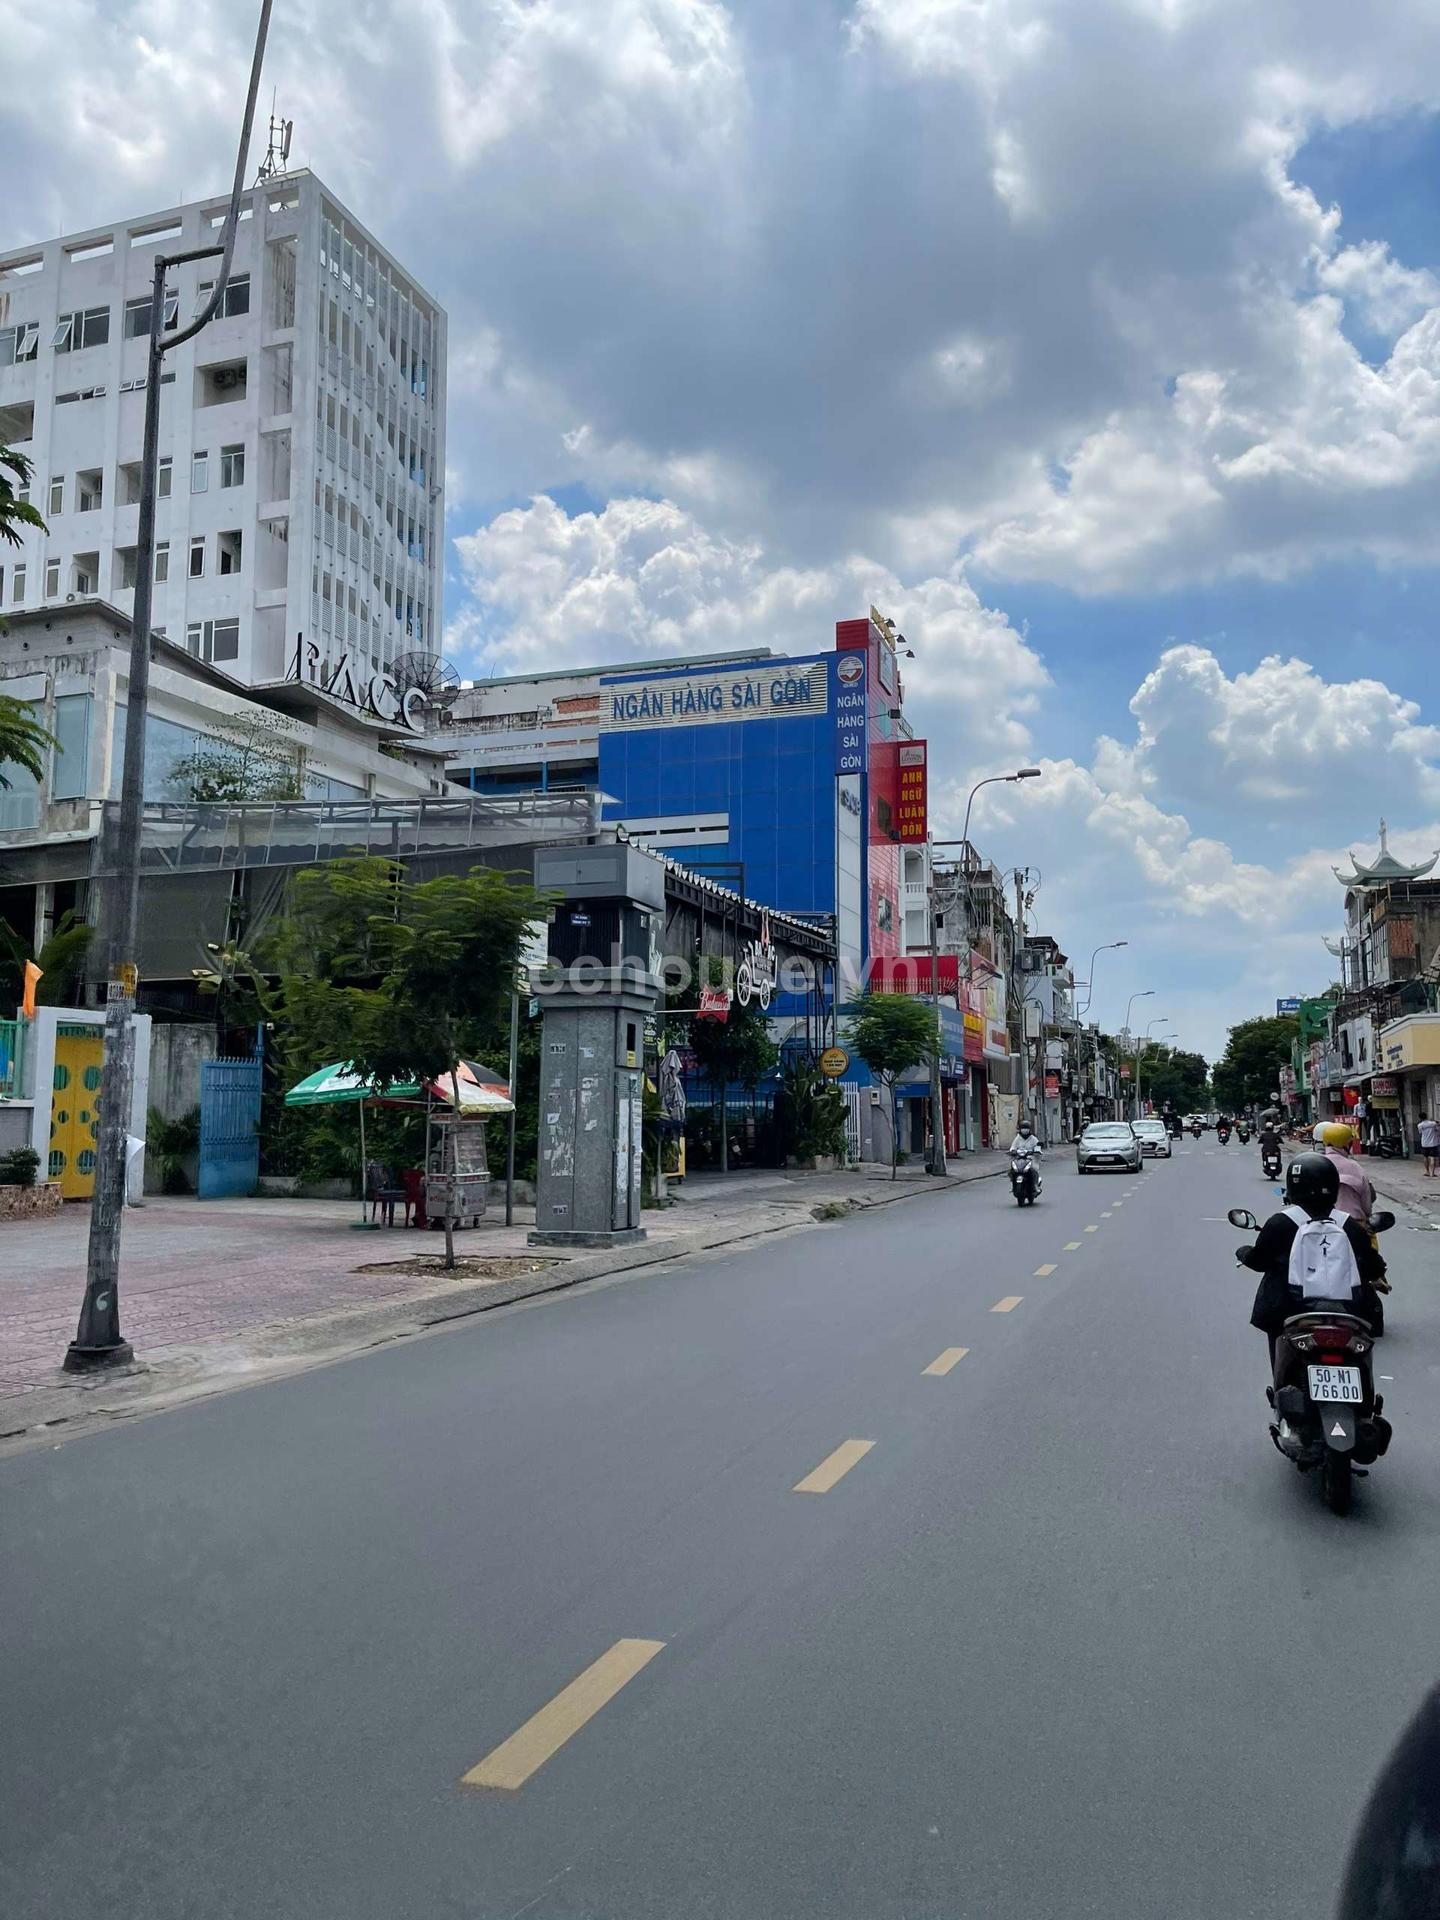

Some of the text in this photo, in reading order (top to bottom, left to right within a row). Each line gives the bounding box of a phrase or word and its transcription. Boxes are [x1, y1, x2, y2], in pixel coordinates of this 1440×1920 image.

[613, 671, 811, 720] NGÂN HÀNG SÀI GÒN
[837, 694, 864, 708] NGÂN
[837, 713, 864, 728] HÀNG
[843, 732, 858, 748] SÀI
[840, 752, 862, 769] GÒN
[902, 771, 923, 785] ANH
[901, 787, 923, 801] NGỮ
[1316, 1368, 1351, 1384] 50-N1
